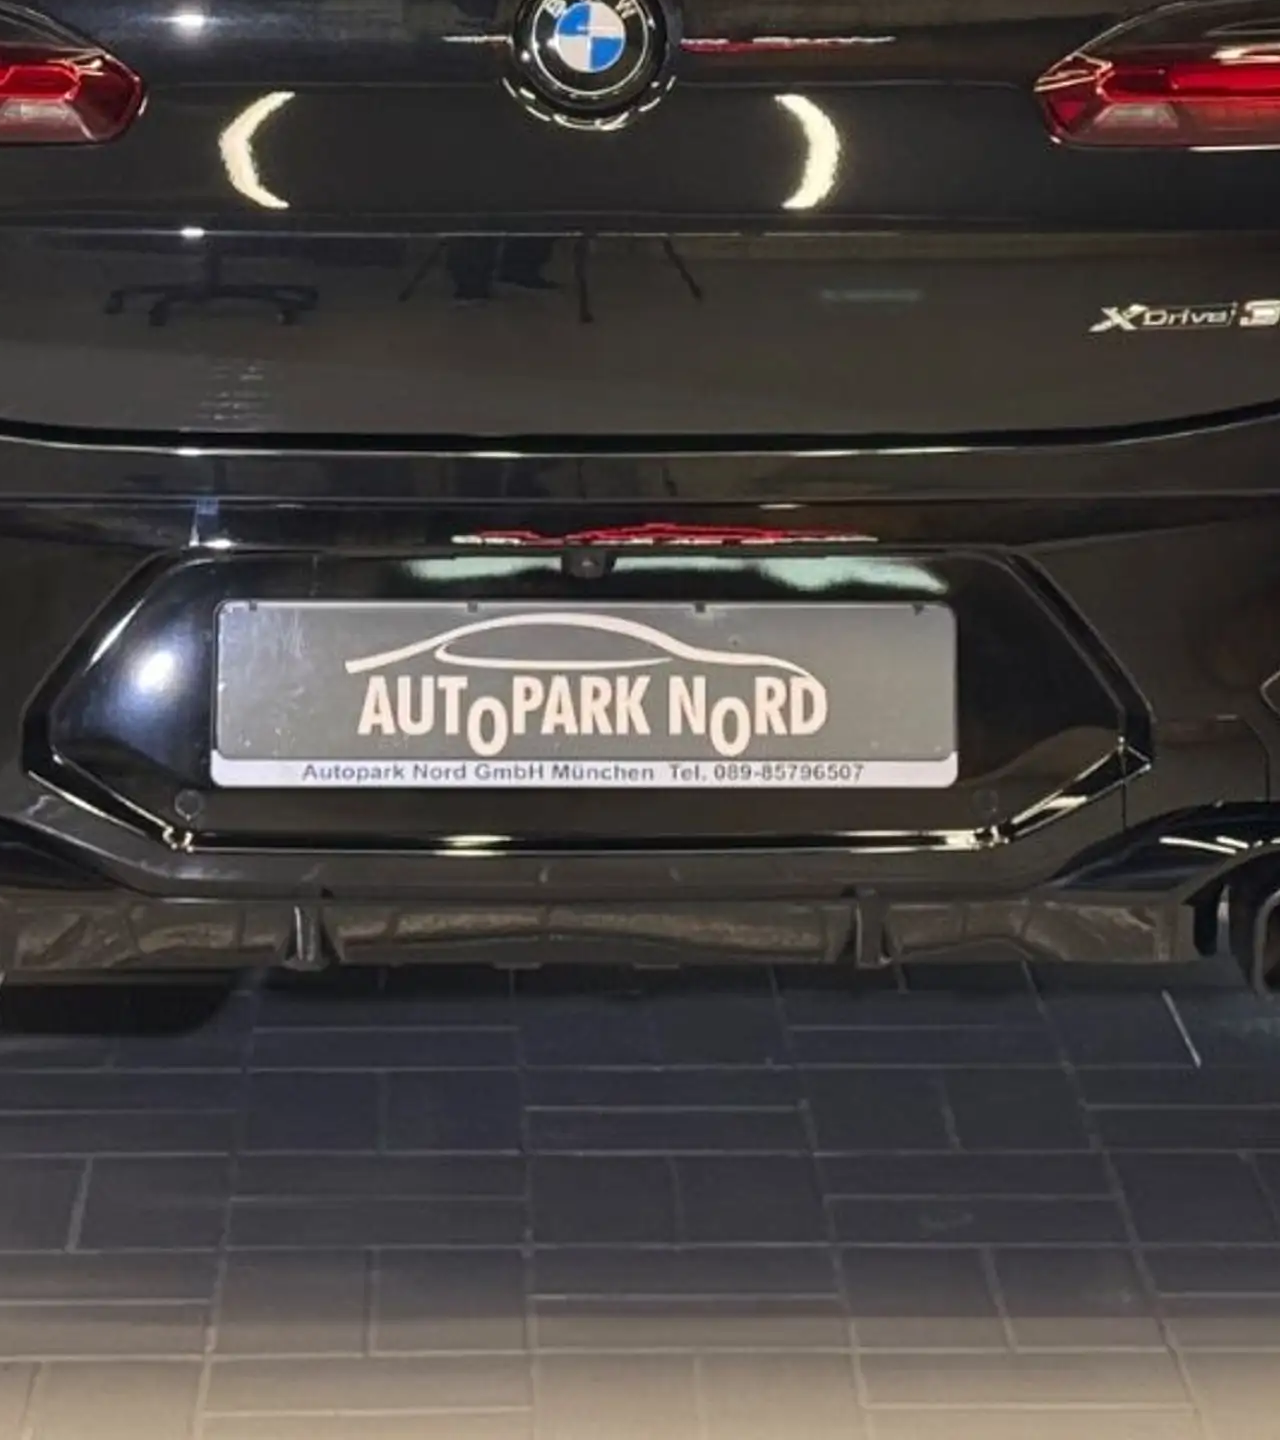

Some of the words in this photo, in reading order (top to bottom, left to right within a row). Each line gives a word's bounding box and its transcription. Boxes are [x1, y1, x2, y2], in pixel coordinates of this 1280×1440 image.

[357, 675, 651, 757] AUTOPARK
[668, 675, 828, 757] NORD
[302, 763, 405, 783] Autopark
[412, 763, 467, 781] Nord
[474, 763, 545, 781] GmbH
[551, 762, 655, 781] München
[670, 763, 707, 781] Tel.
[713, 763, 865, 782] 089-85796507
